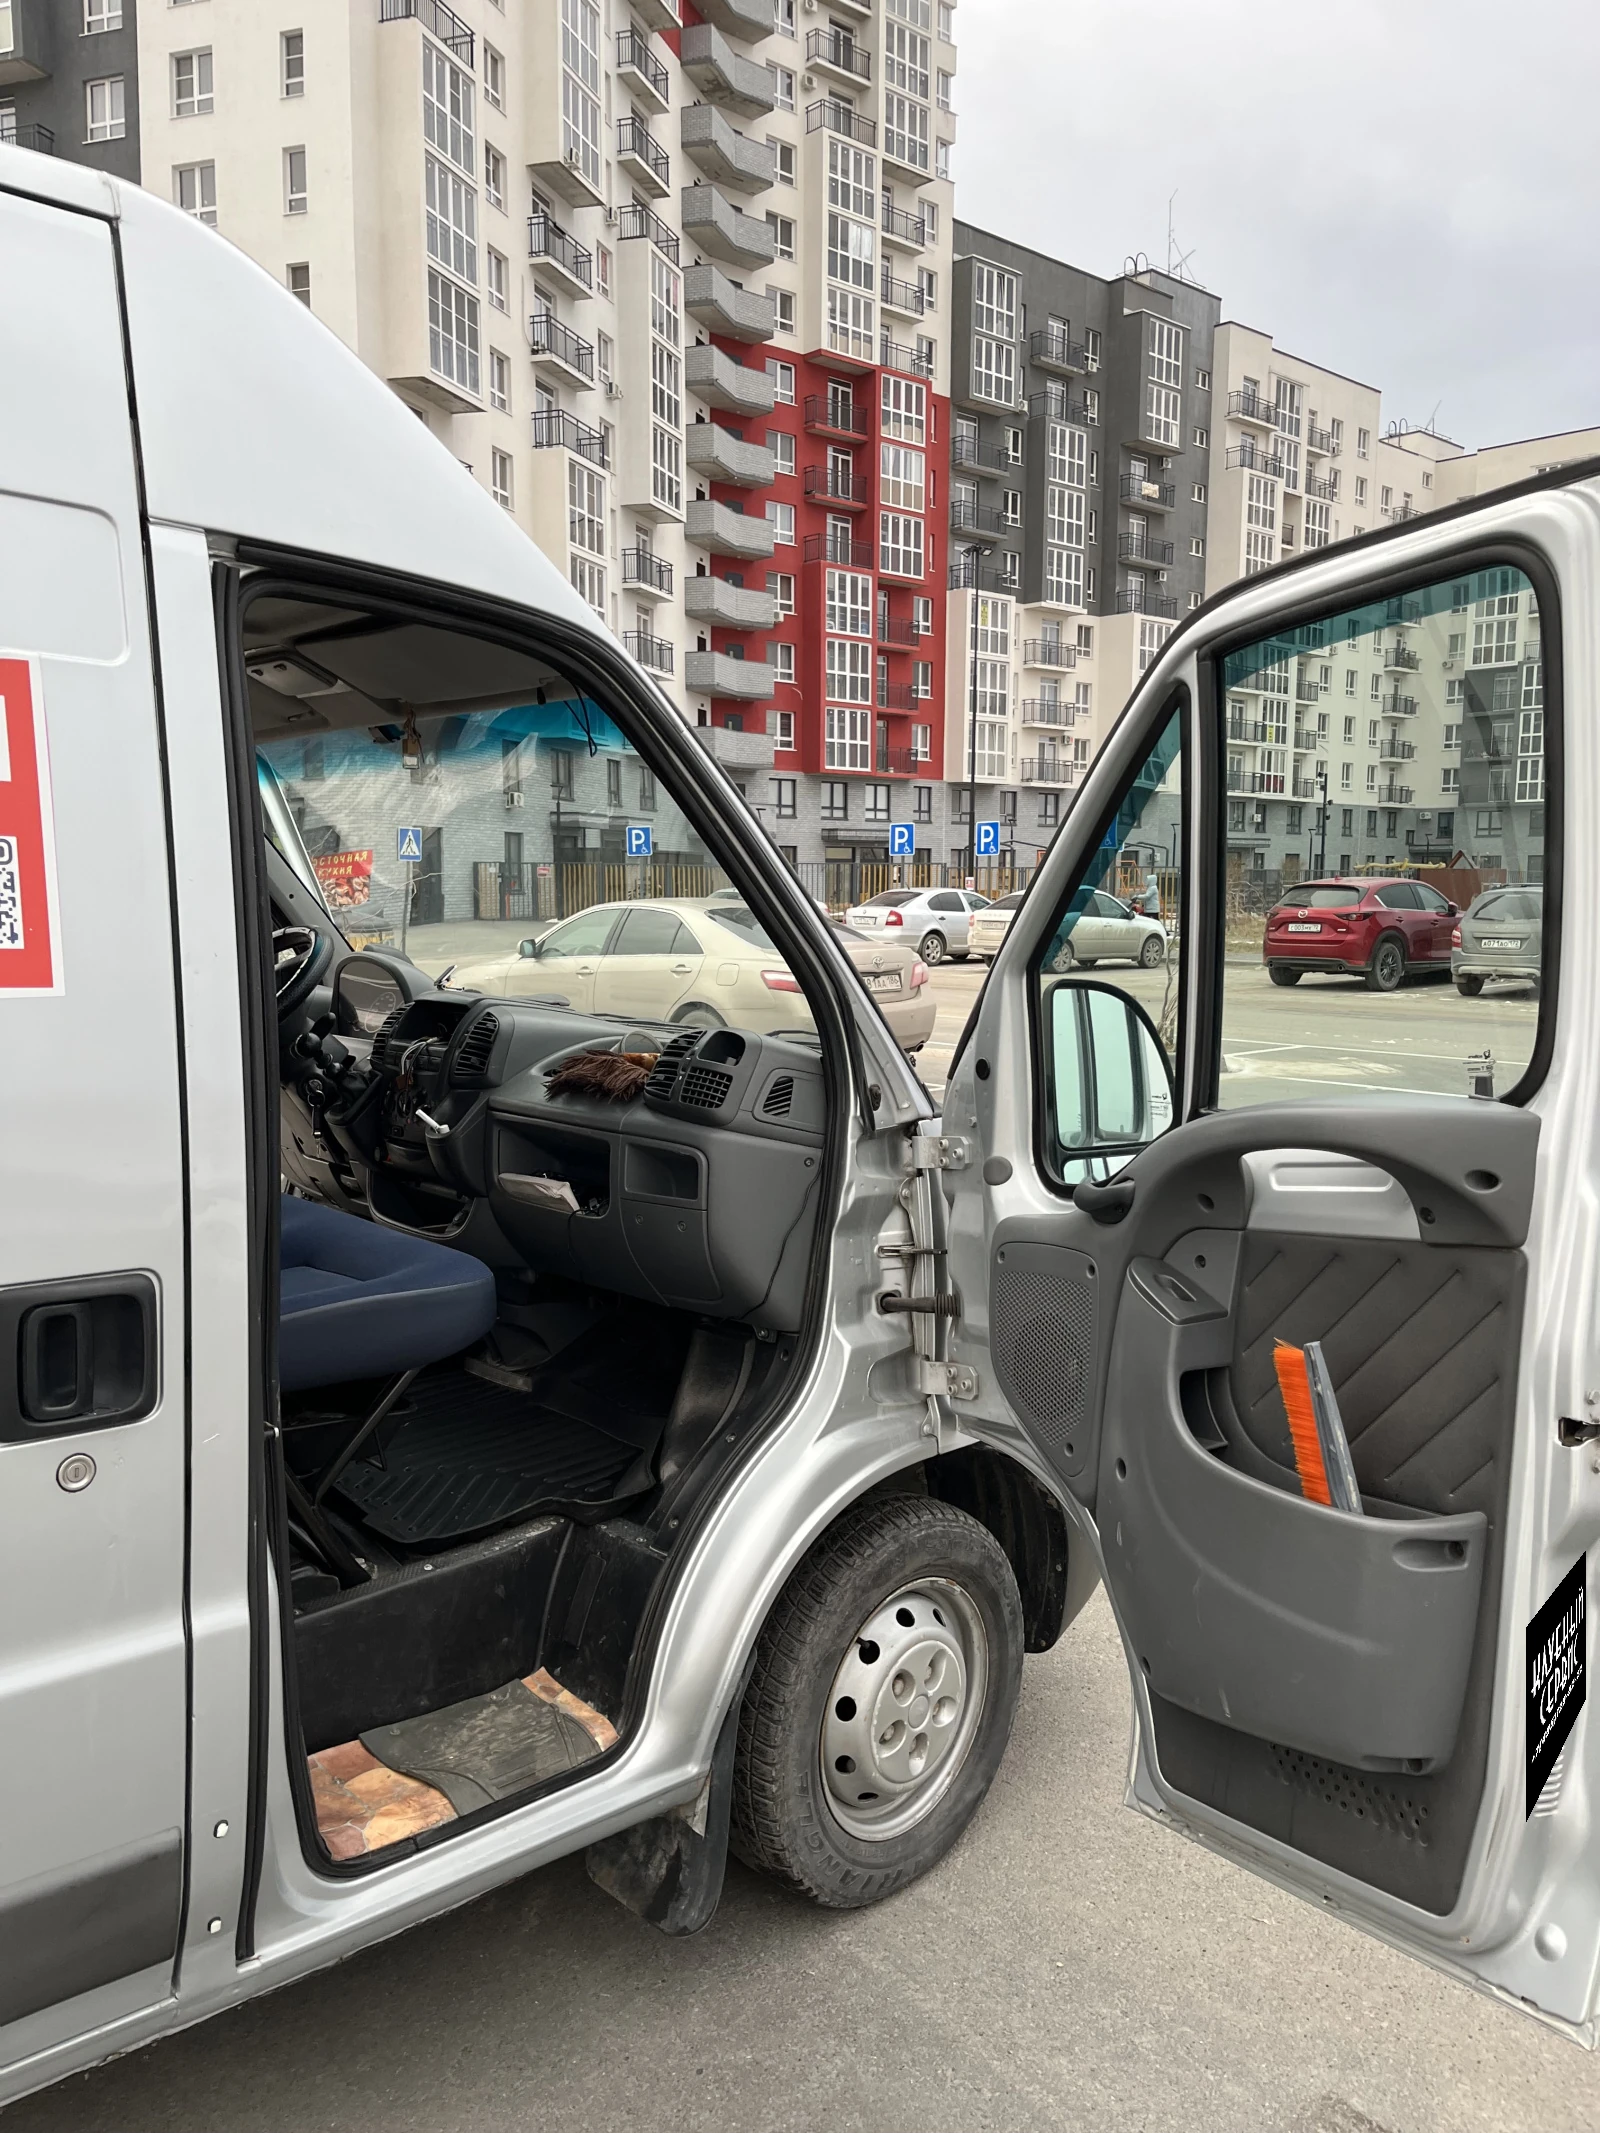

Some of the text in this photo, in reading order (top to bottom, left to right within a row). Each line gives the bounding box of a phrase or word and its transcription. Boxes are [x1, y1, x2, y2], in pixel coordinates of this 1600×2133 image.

[631, 829, 646, 853] P
[894, 827, 909, 852] P
[980, 825, 995, 852] P
[311, 850, 368, 866] ОСТОЧНАЯ
